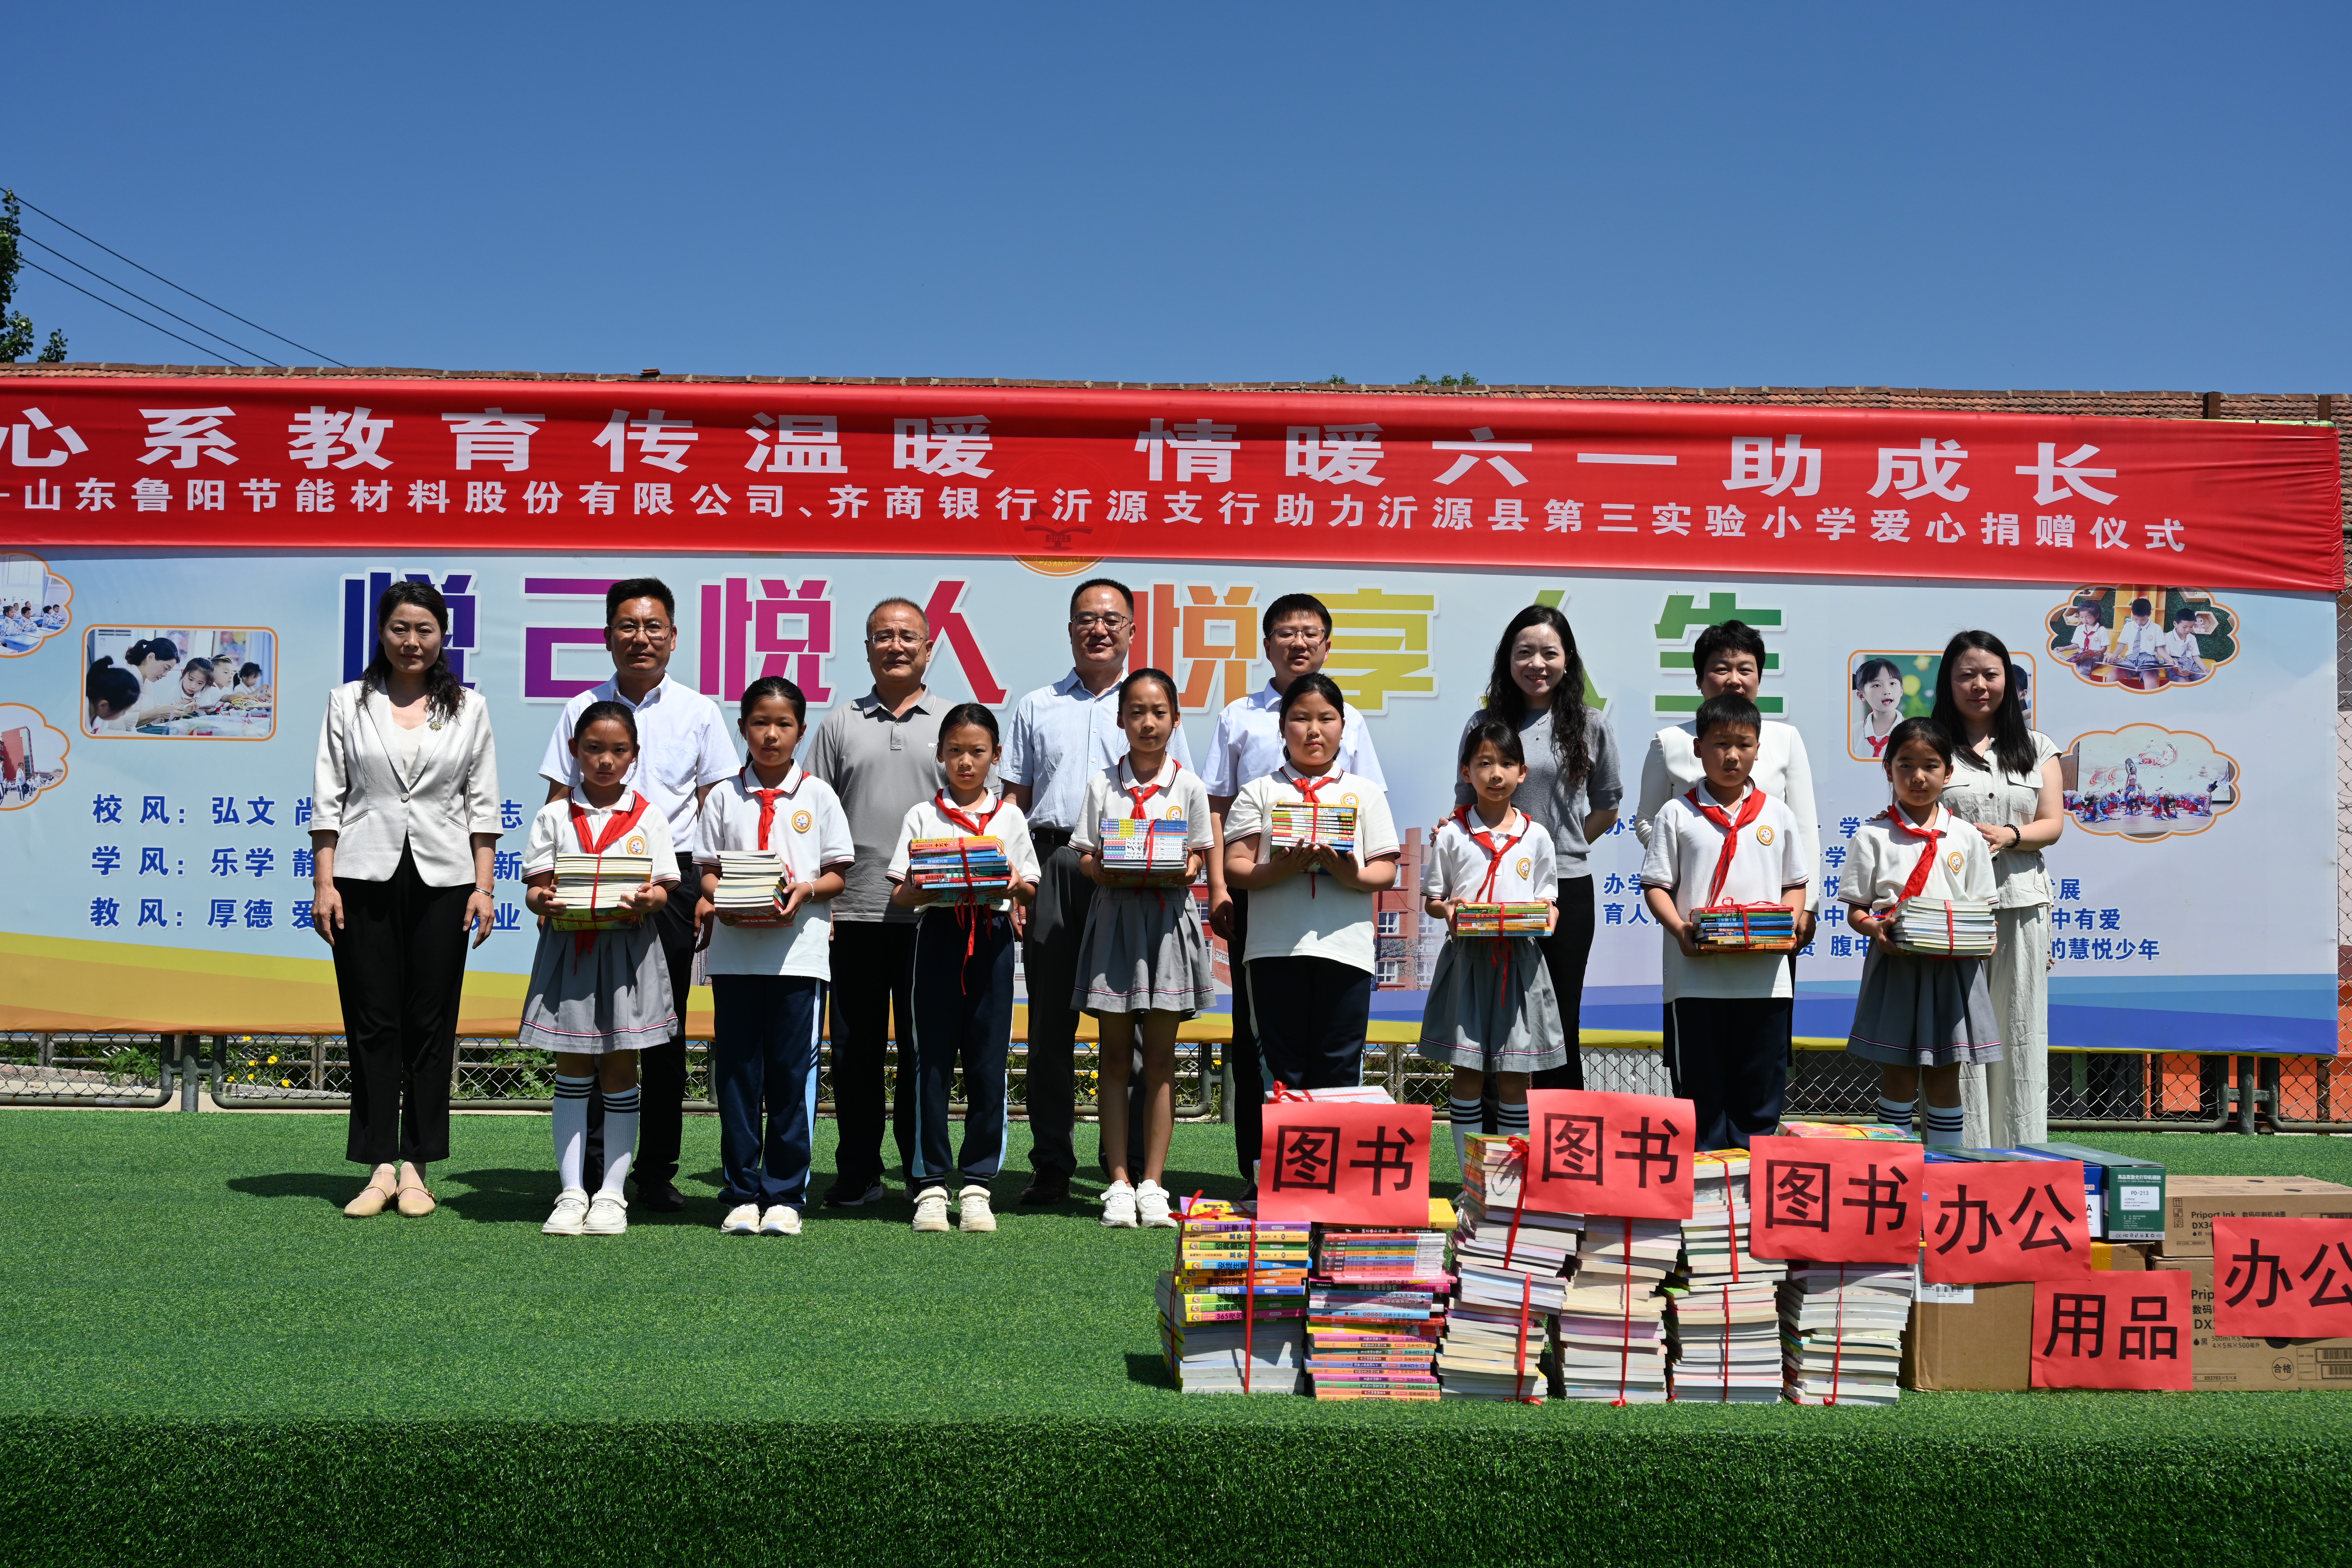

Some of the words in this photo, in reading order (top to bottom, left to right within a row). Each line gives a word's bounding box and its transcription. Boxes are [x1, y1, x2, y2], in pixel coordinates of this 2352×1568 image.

[0, 406, 994, 479] 心系教育传温暖
[1134, 418, 2118, 506] 情暖六一助成长
[1134, 583, 1784, 714] 悦享生
[212, 796, 276, 826] 弘文
[210, 847, 275, 878] 乐学
[208, 899, 274, 928] 厚德
[1603, 903, 1661, 925] 育人
[2051, 908, 2121, 931] 中有爱
[1272, 1125, 1416, 1196] 图书
[1541, 1113, 1680, 1189] 图书
[1765, 1159, 1909, 1235] 图书
[1935, 1184, 2076, 1255] 办公
[2191, 1211, 2220, 1220] Priport
[2225, 1238, 2352, 1308] 办公
[2192, 1305, 2214, 1315] 数码
[2194, 1319, 2215, 1330] DX
[2042, 1292, 2178, 1360] 用品
[2273, 1364, 2292, 1374] 合格
